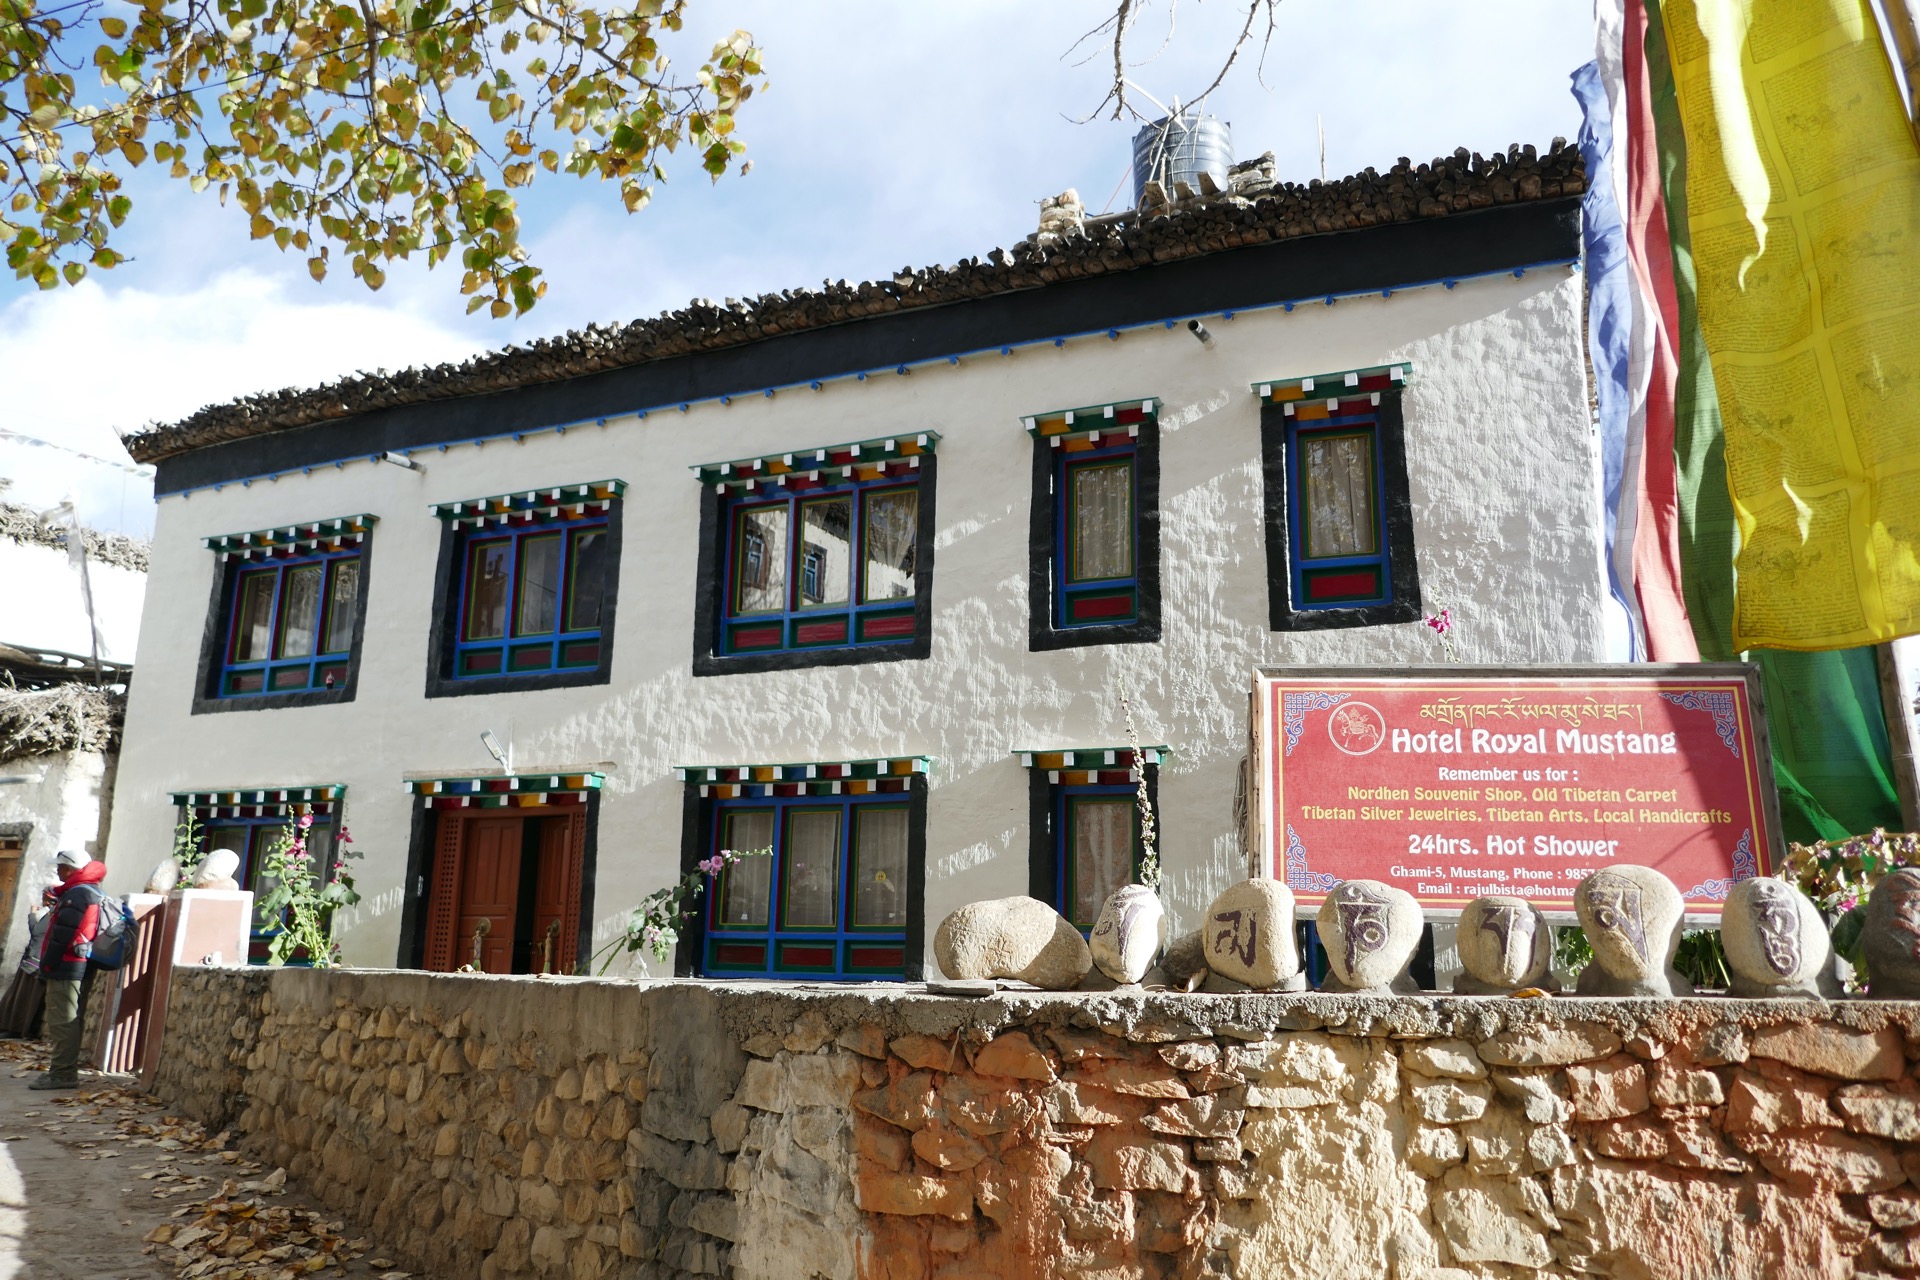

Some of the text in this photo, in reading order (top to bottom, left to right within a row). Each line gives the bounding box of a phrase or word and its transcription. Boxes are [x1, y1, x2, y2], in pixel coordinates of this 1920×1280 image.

[1391, 728, 1678, 755] Hotel Royal Mustang
[1437, 767, 1519, 781] Remember
[1522, 769, 1541, 781] us
[1545, 767, 1569, 781] for
[1347, 786, 1678, 803] Nordhen Souvenir Shop, Old Tibetan Carpet
[1301, 805, 1732, 823] Tibetan Silver Jewelries, Tibetan Arts, Local Handicrafts
[1408, 834, 1619, 857] 24hrs. Hot Shower
[1390, 865, 1447, 879] Ghami-5,
[1450, 867, 1510, 881] Mustang,
[1513, 868, 1553, 880] Phone
[1417, 882, 1453, 895] Email
